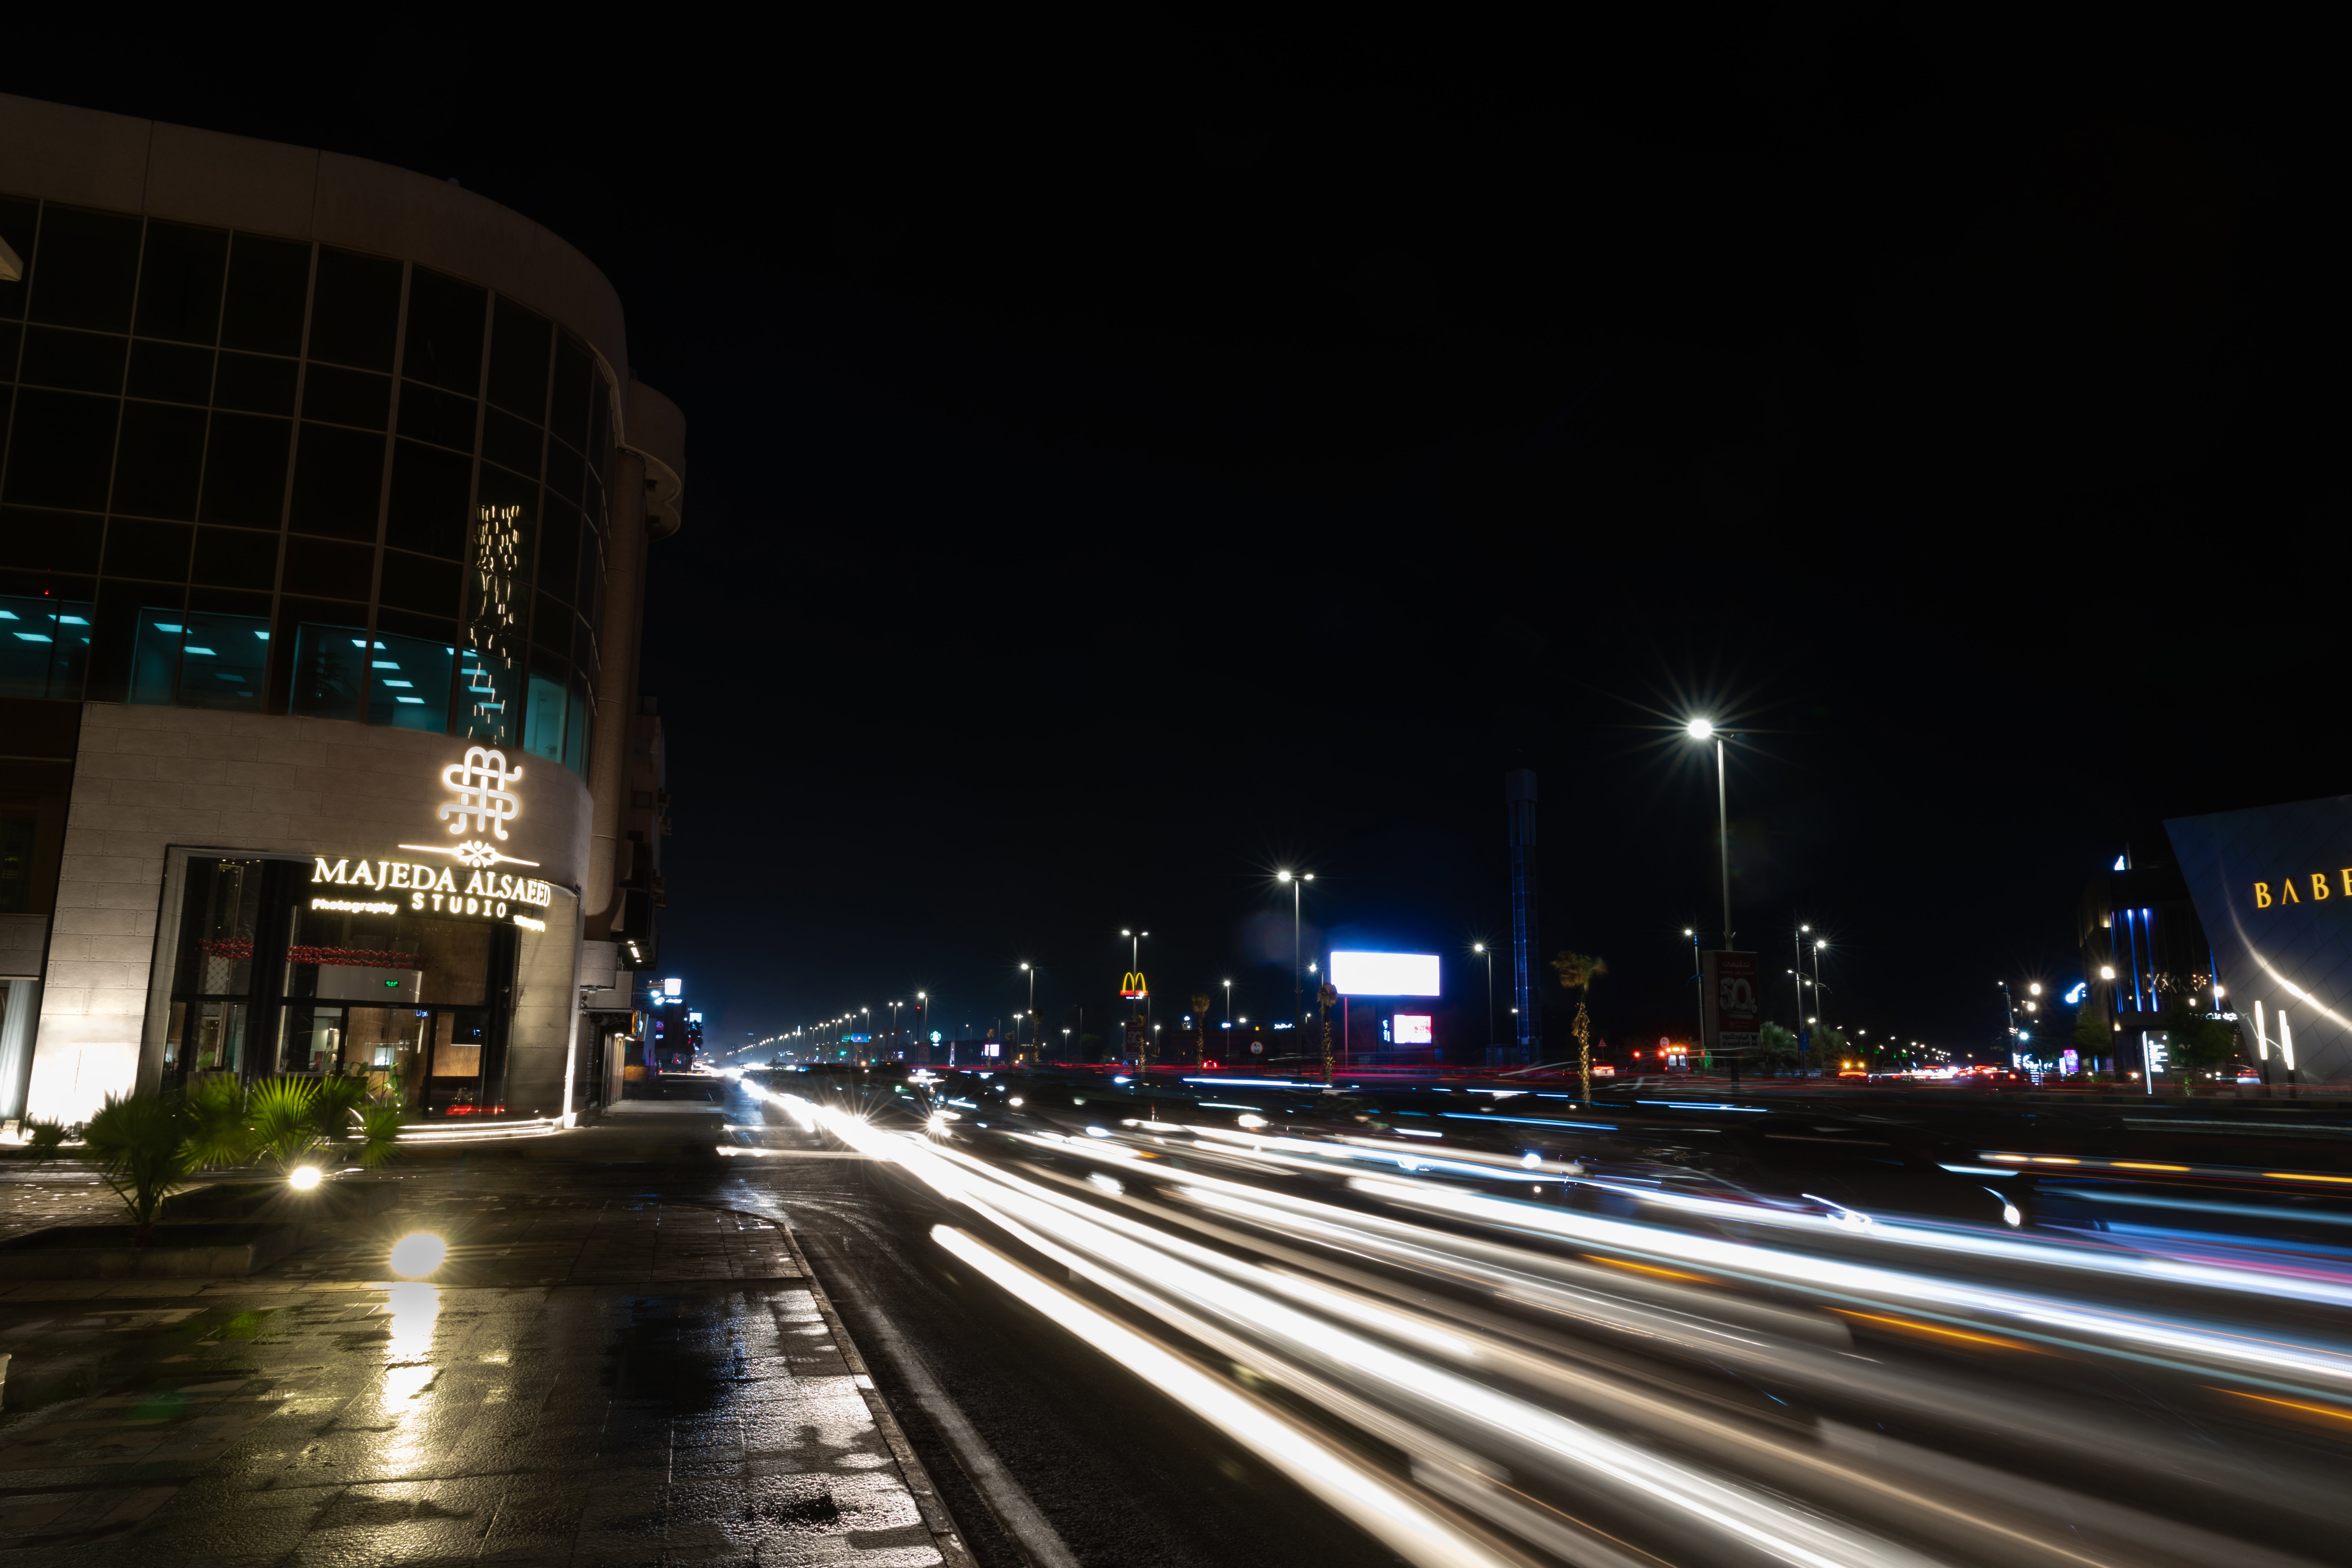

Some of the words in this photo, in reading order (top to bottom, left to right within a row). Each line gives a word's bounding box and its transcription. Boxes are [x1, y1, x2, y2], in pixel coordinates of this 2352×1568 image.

[311, 858, 457, 892] MAJEDA
[465, 870, 551, 908] ALSAEED
[2253, 868, 2352, 908] BABE
[312, 899, 398, 915] Photography
[412, 892, 506, 918] STUDIO
